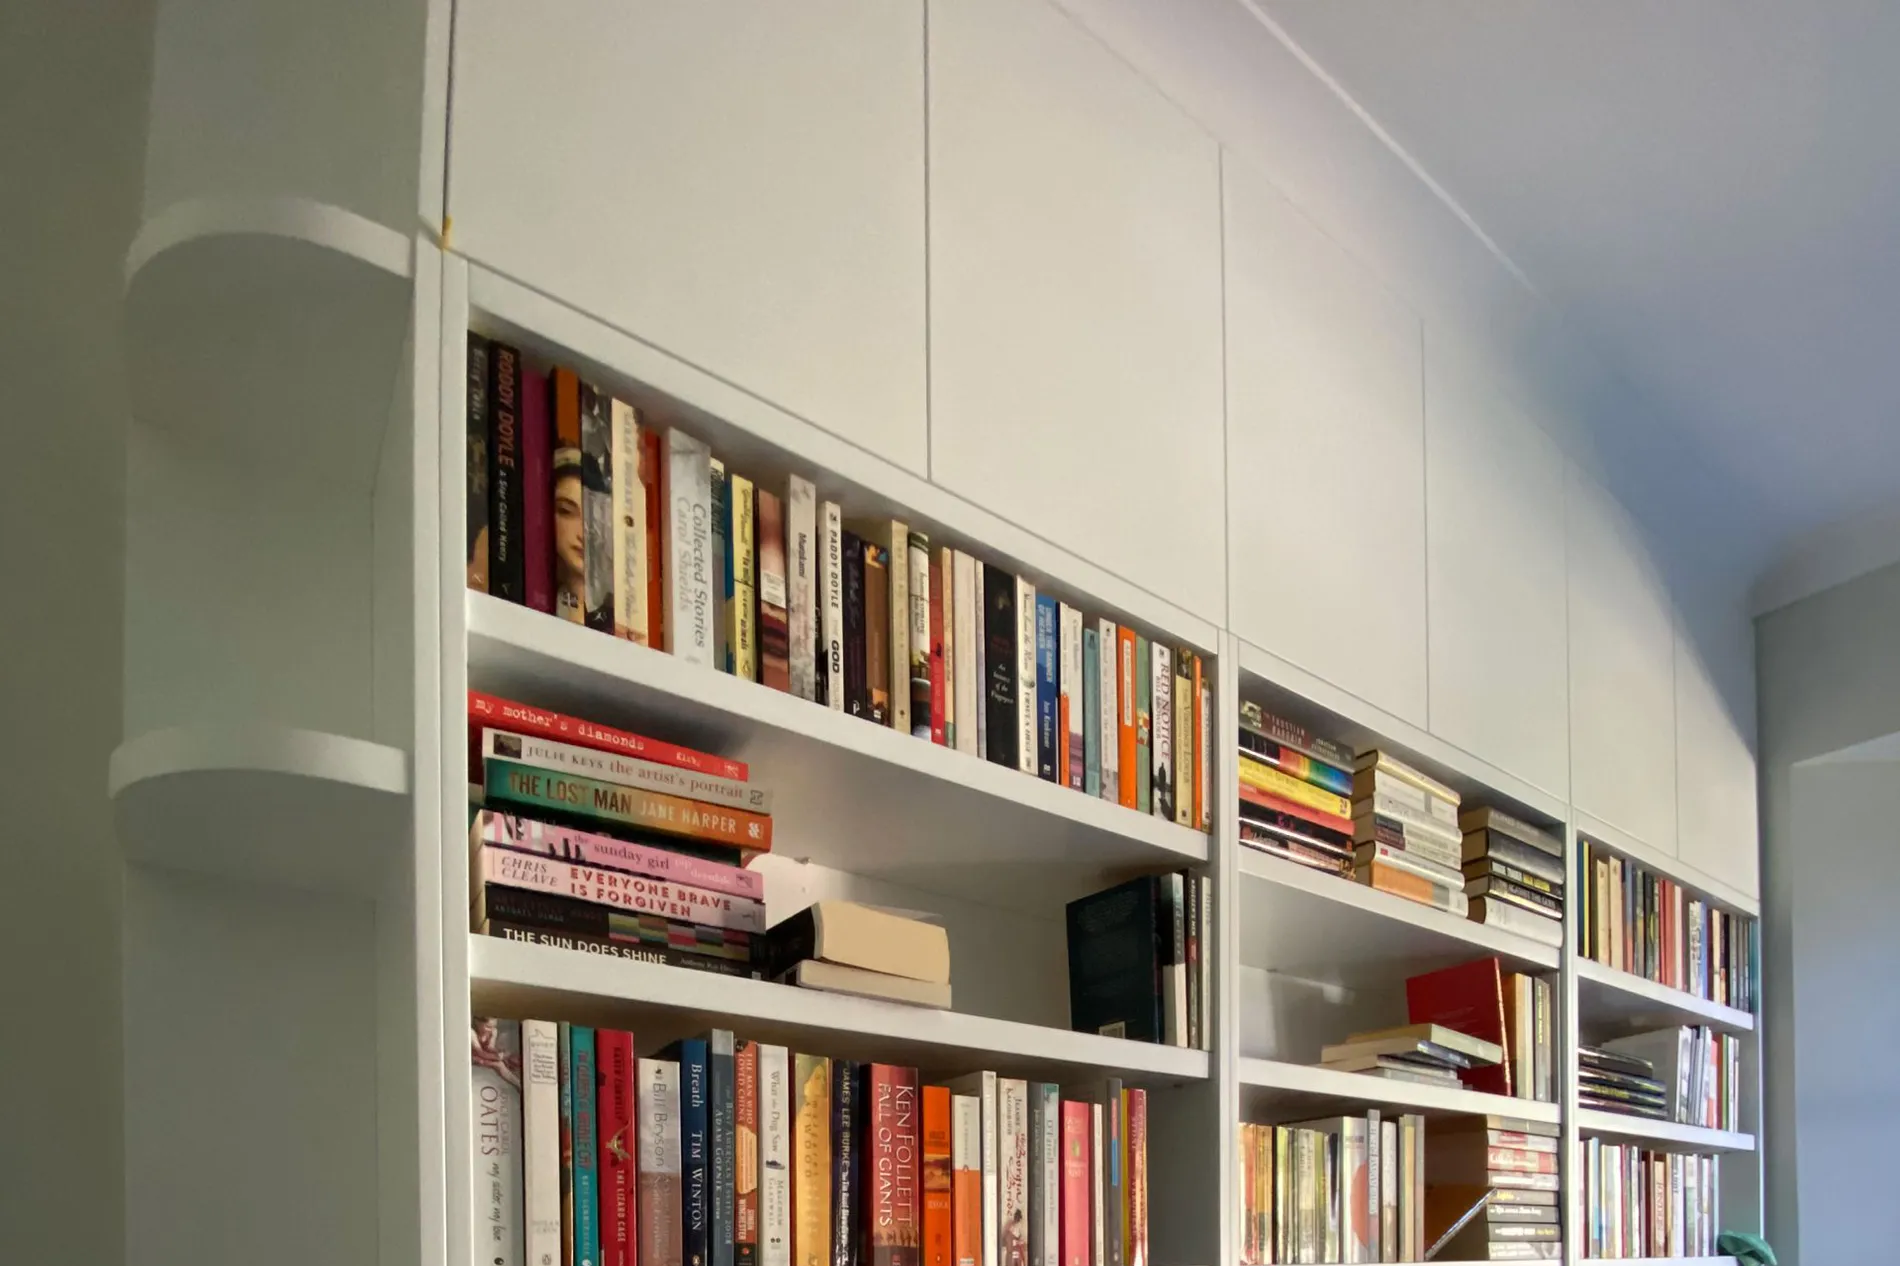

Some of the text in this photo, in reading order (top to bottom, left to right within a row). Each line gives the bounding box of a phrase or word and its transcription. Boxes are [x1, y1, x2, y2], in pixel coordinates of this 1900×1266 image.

[498, 349, 514, 466] RODDY DOYLE
[677, 496, 693, 612] Carol Shields
[830, 530, 838, 567] PADDY
[692, 503, 707, 647] Collected Stories
[832, 640, 840, 673] GOD
[474, 698, 644, 752] my mother's diamonds
[1160, 663, 1170, 759] RED NOTICE
[526, 745, 604, 770] JULIE KEYS
[609, 757, 743, 800] the artist's portrait
[508, 771, 632, 815] THE LOST MAN
[639, 798, 737, 834] JANE HARPER
[501, 855, 549, 875] CHRIS
[501, 866, 558, 888] CLEAVE
[594, 842, 643, 868] sunday
[647, 854, 671, 872] girl
[569, 867, 670, 899] EVERYONE
[676, 890, 731, 911] BRAVE
[570, 883, 692, 917] IS FORGIVEN
[503, 927, 537, 945] THE
[540, 933, 573, 951] SUN
[577, 940, 619, 959] DOES
[623, 948, 666, 966] SHINE
[480, 1085, 499, 1156] OATES
[652, 1082, 668, 1168] Bill Bryson
[769, 1071, 781, 1152] What Dog Saw
[842, 1108, 850, 1127] LEE
[691, 1063, 703, 1231] Breath TIM WINTON
[715, 1109, 723, 1191] ADAM GOPNIK
[842, 1131, 850, 1167] BURKE
[878, 1083, 892, 1227] FALL OF GIANTS
[896, 1085, 914, 1226] KEN FOLLETT
[491, 1162, 503, 1241] my my love
[616, 1169, 626, 1242] THE LIZARD CAGE
